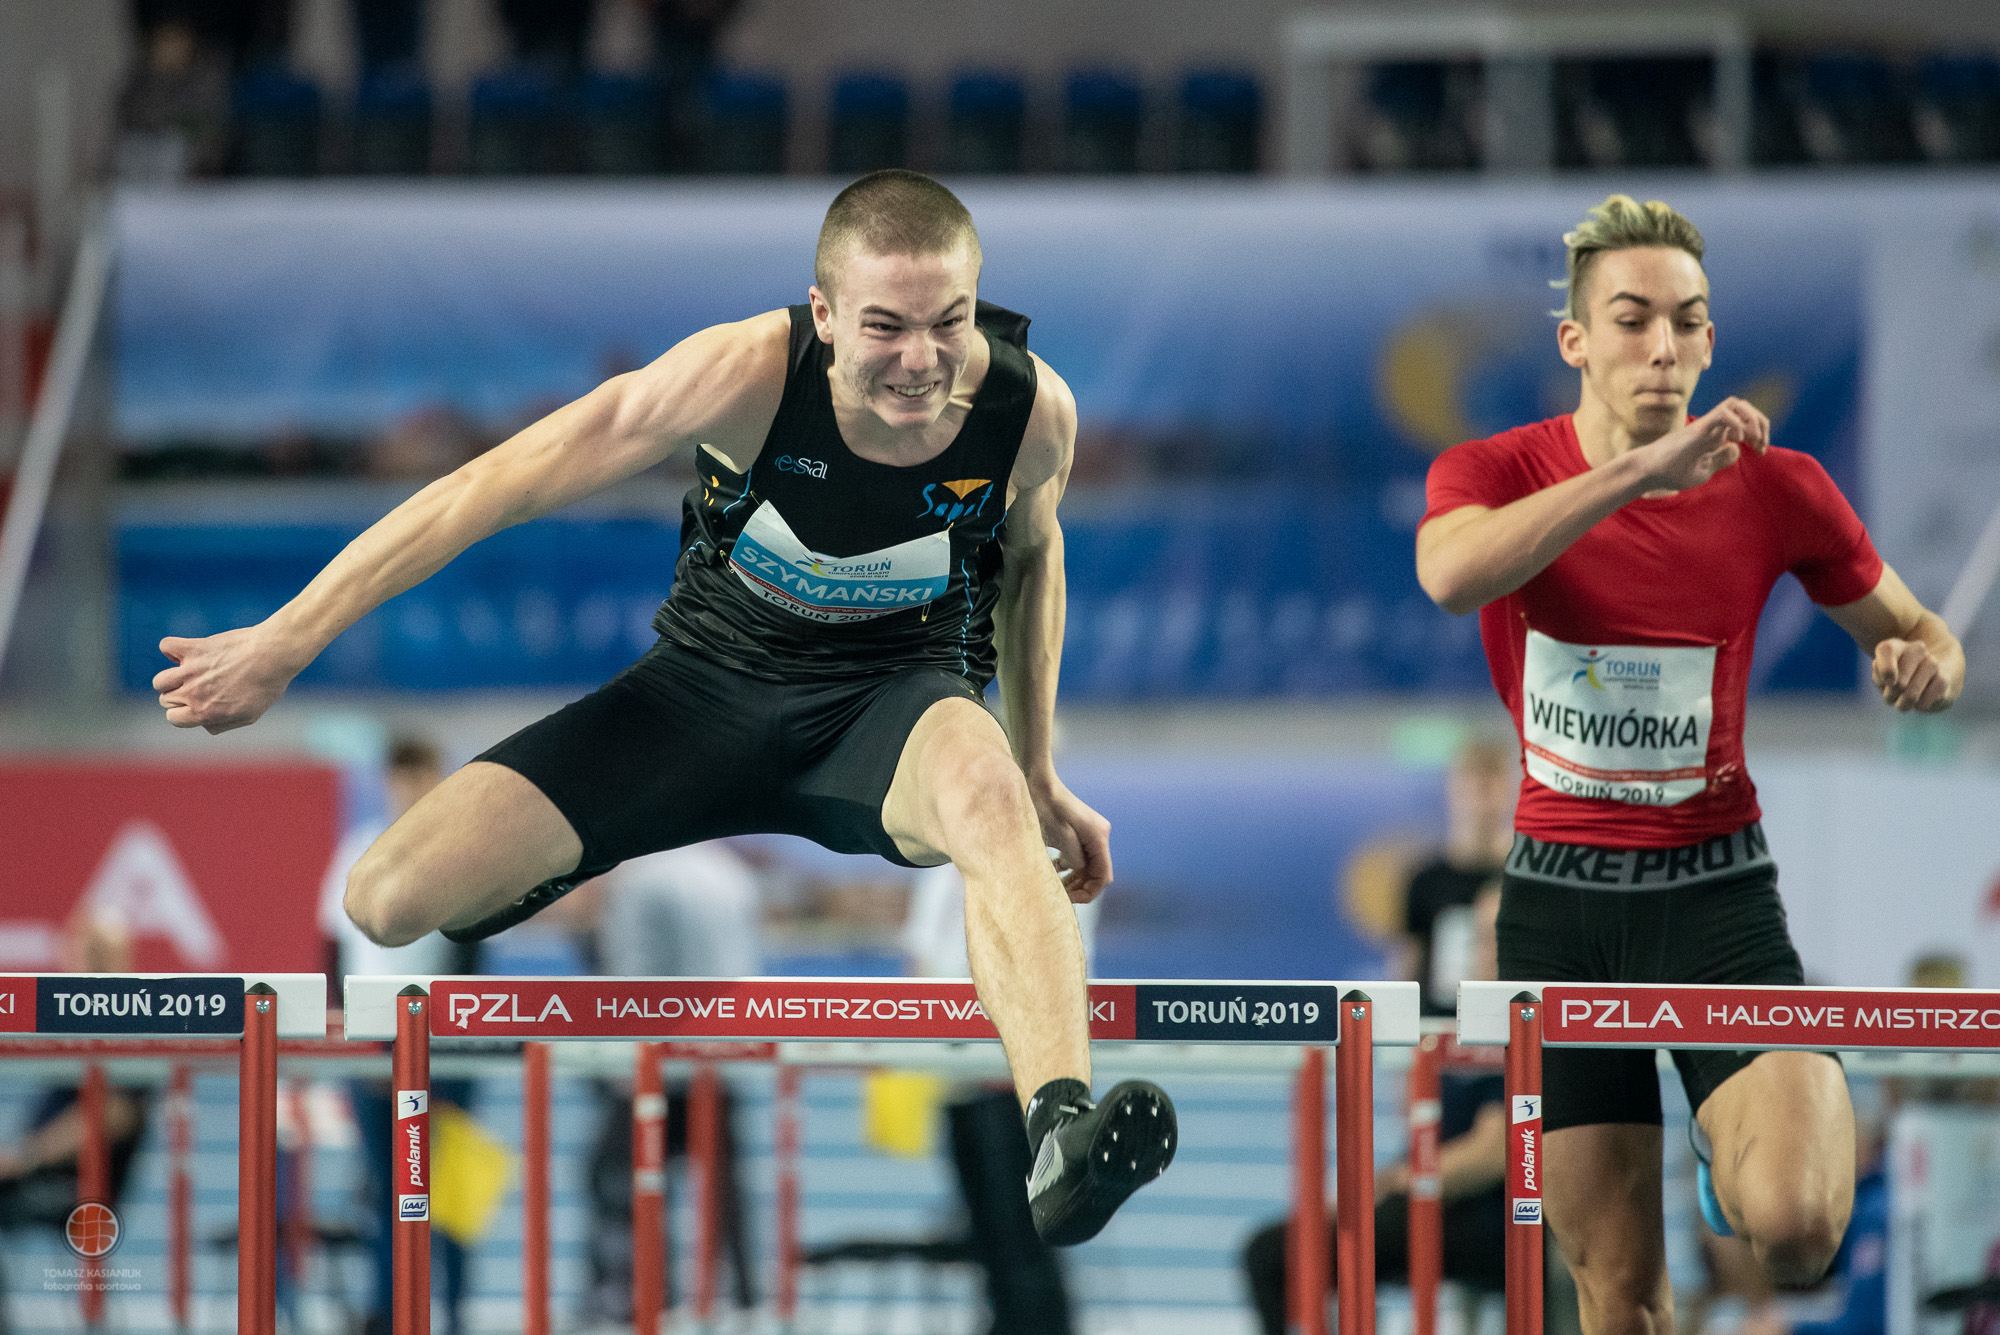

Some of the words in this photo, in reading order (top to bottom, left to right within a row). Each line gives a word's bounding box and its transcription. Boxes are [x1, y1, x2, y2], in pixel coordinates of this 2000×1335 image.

[740, 546, 933, 602] SZYMAŃSKI
[831, 557, 892, 572] TORUŃ
[763, 590, 831, 621] TORUŃ
[1530, 692, 1697, 749] WIEWIÓRKA
[1515, 836, 1623, 883] NIKE
[1632, 834, 1735, 884] PRO
[53, 989, 152, 1016] TORUŃ
[158, 994, 226, 1016] 2019
[449, 993, 573, 1023] PZLA
[597, 997, 736, 1018] HALOWE
[745, 997, 991, 1020] MISTRZOSTWA
[1152, 996, 1247, 1024] TORUŃ
[1251, 1001, 1320, 1028] 2019
[1561, 999, 1684, 1029] PZLA
[1707, 1004, 1845, 1028] HALOWE
[1853, 1006, 2000, 1030] MISTRZO
[406, 1123, 424, 1187] polanik
[1521, 1128, 1538, 1191] polanik
[404, 1201, 426, 1210] IAAF
[1518, 1205, 1539, 1213] IAAF
